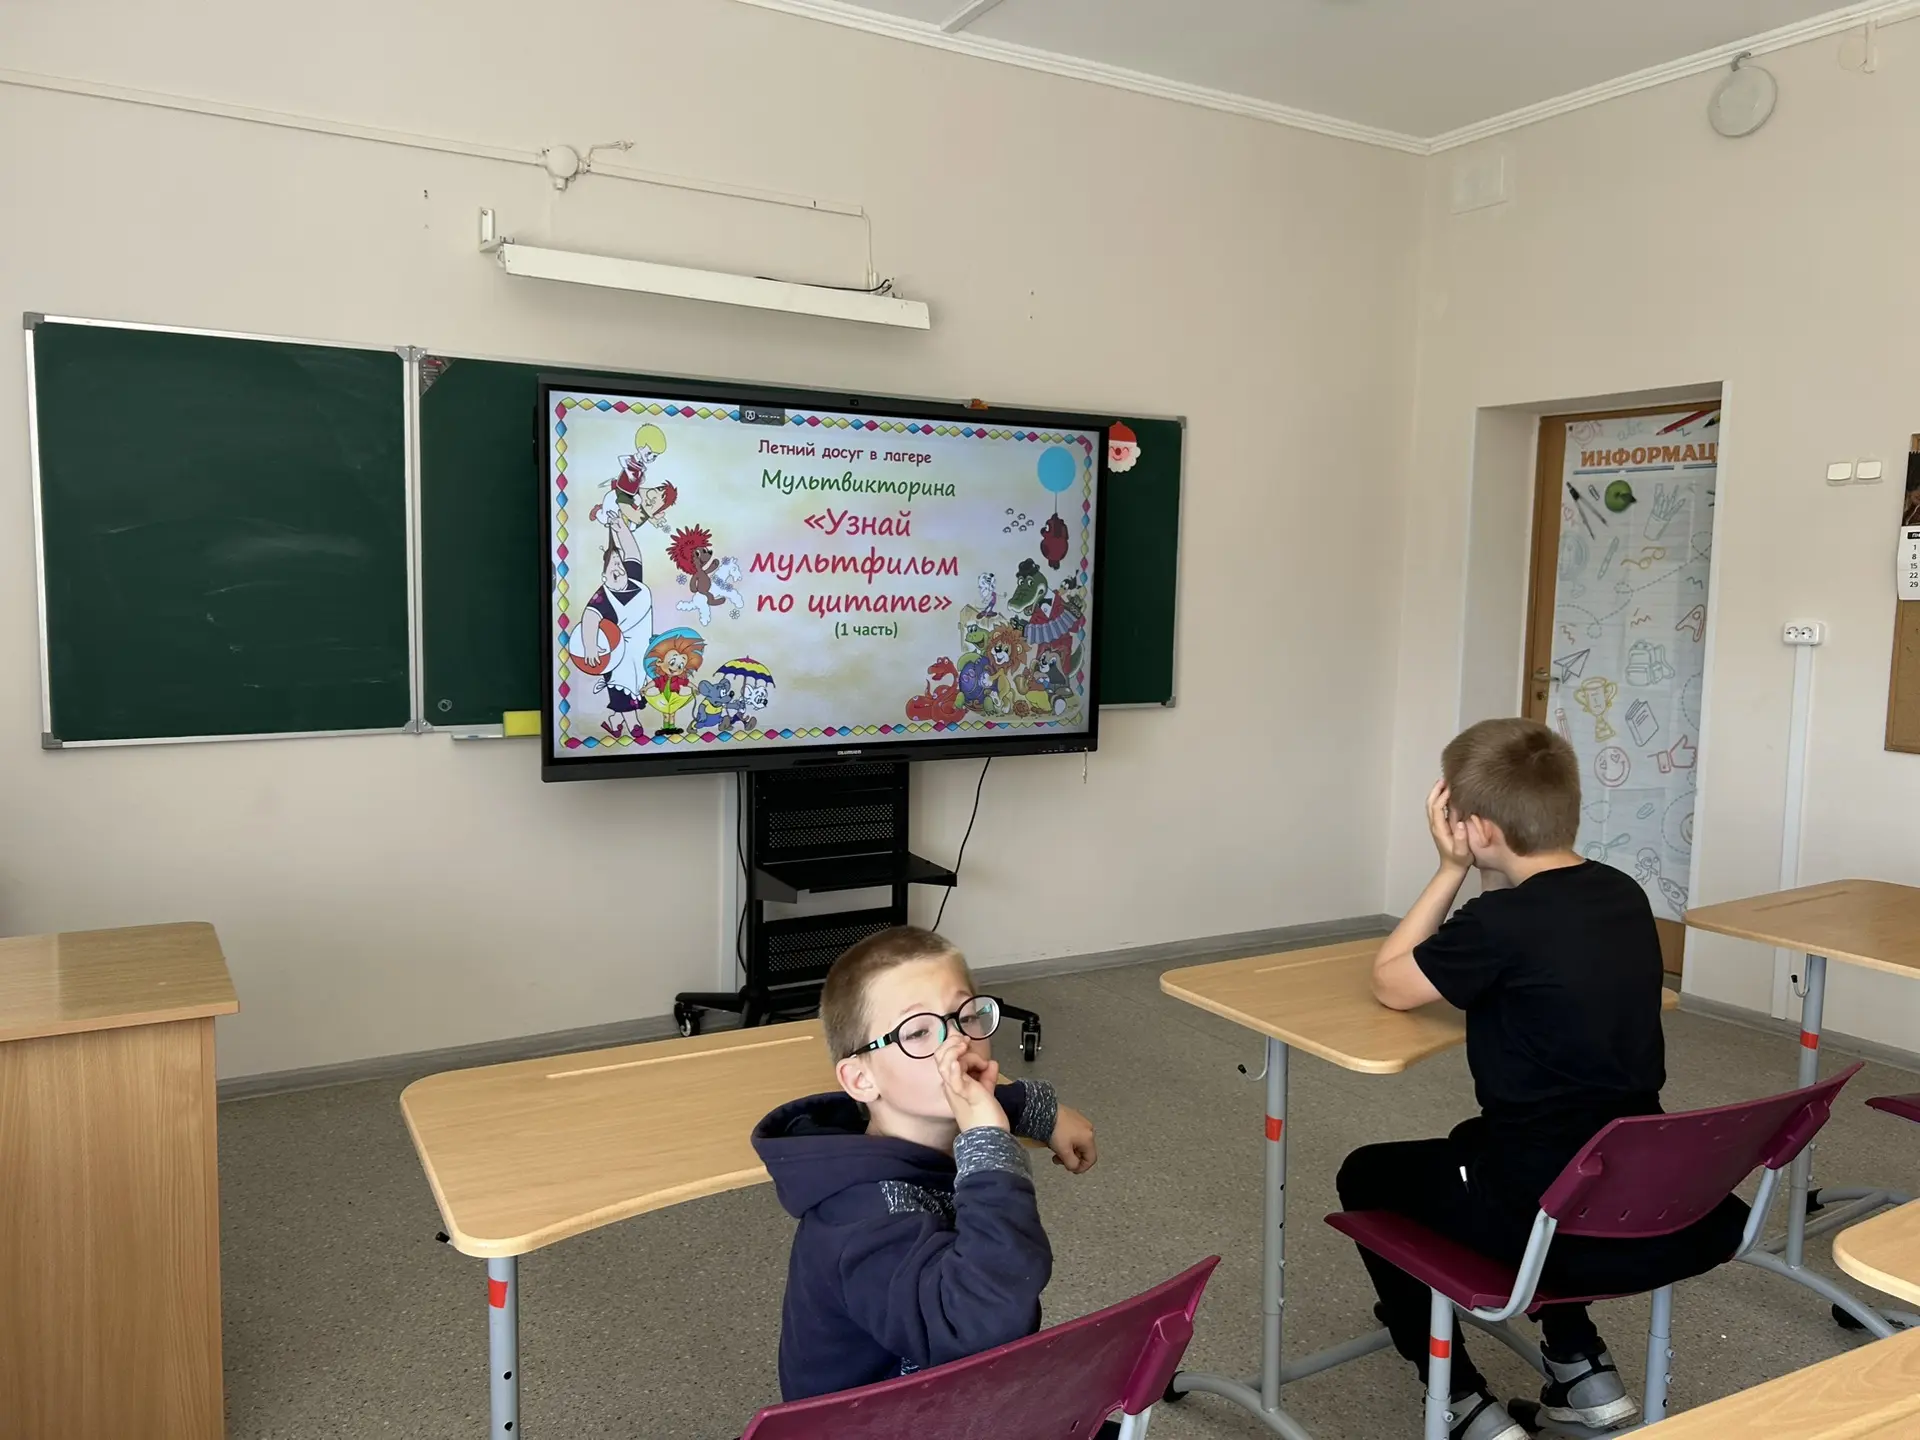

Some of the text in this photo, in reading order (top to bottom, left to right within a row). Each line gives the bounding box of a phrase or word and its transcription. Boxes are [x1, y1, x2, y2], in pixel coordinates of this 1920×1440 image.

[758, 439, 932, 467] Летний досуг в лагере
[761, 469, 956, 502] Мультвикторина
[804, 508, 911, 537] «Узнай
[749, 547, 959, 584] мультфильм
[757, 593, 953, 618] по цитате»
[834, 622, 898, 638] (1 часть)
